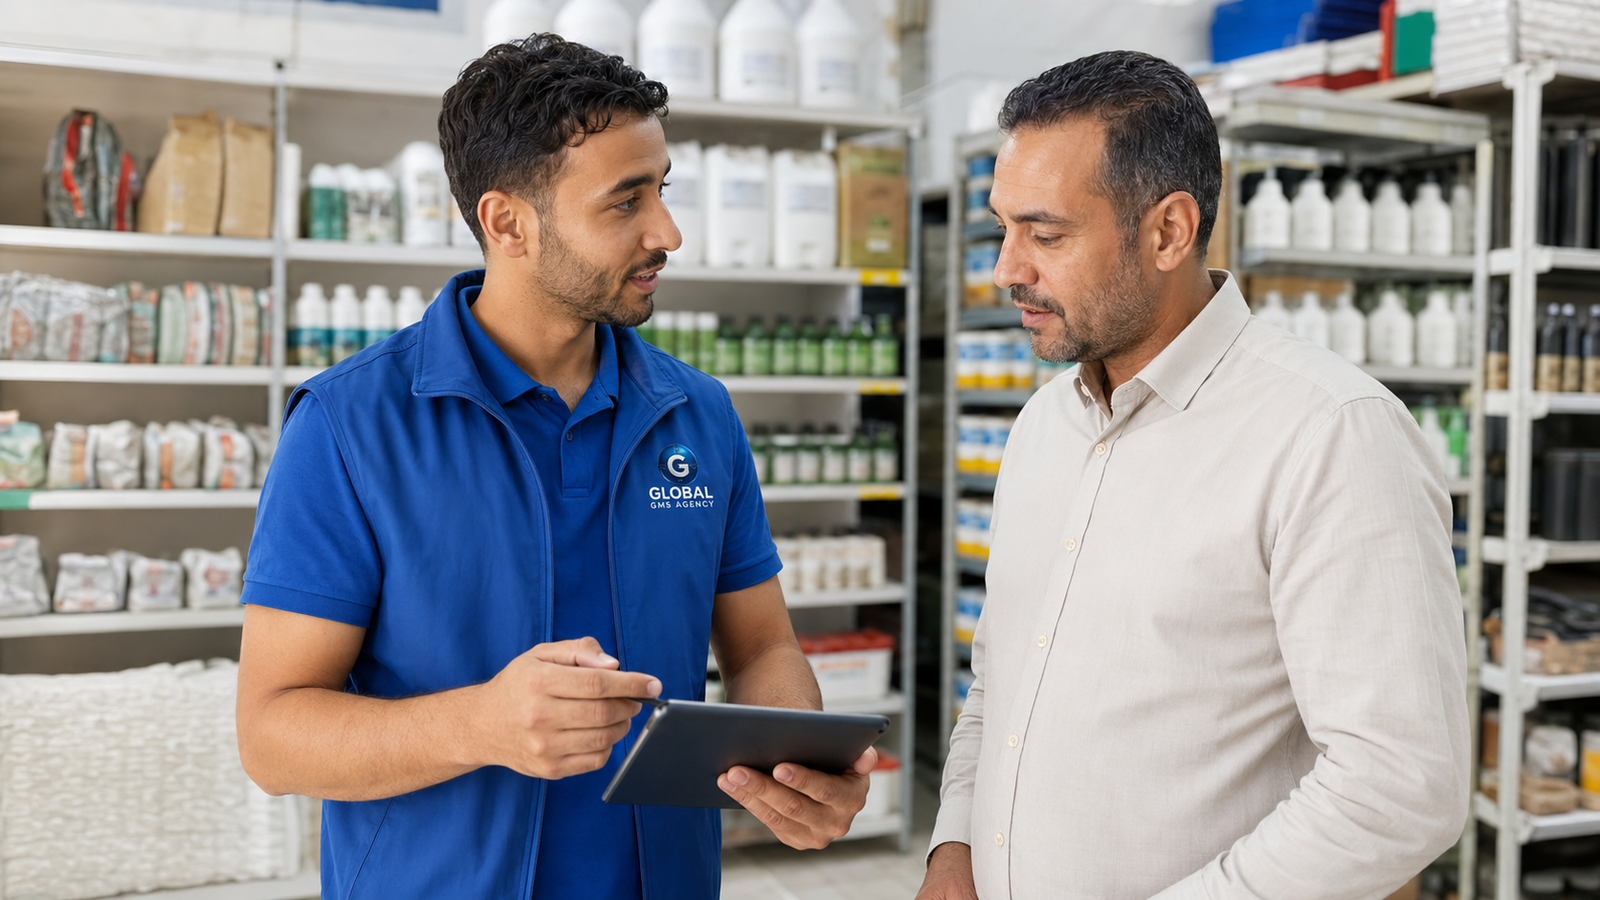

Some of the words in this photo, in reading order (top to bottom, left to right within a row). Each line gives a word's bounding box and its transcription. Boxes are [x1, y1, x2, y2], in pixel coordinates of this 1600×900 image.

[667, 454, 690, 478] G
[649, 486, 714, 500] GLOBAL
[650, 501, 671, 509] GMS
[676, 500, 714, 508] AGENCY
